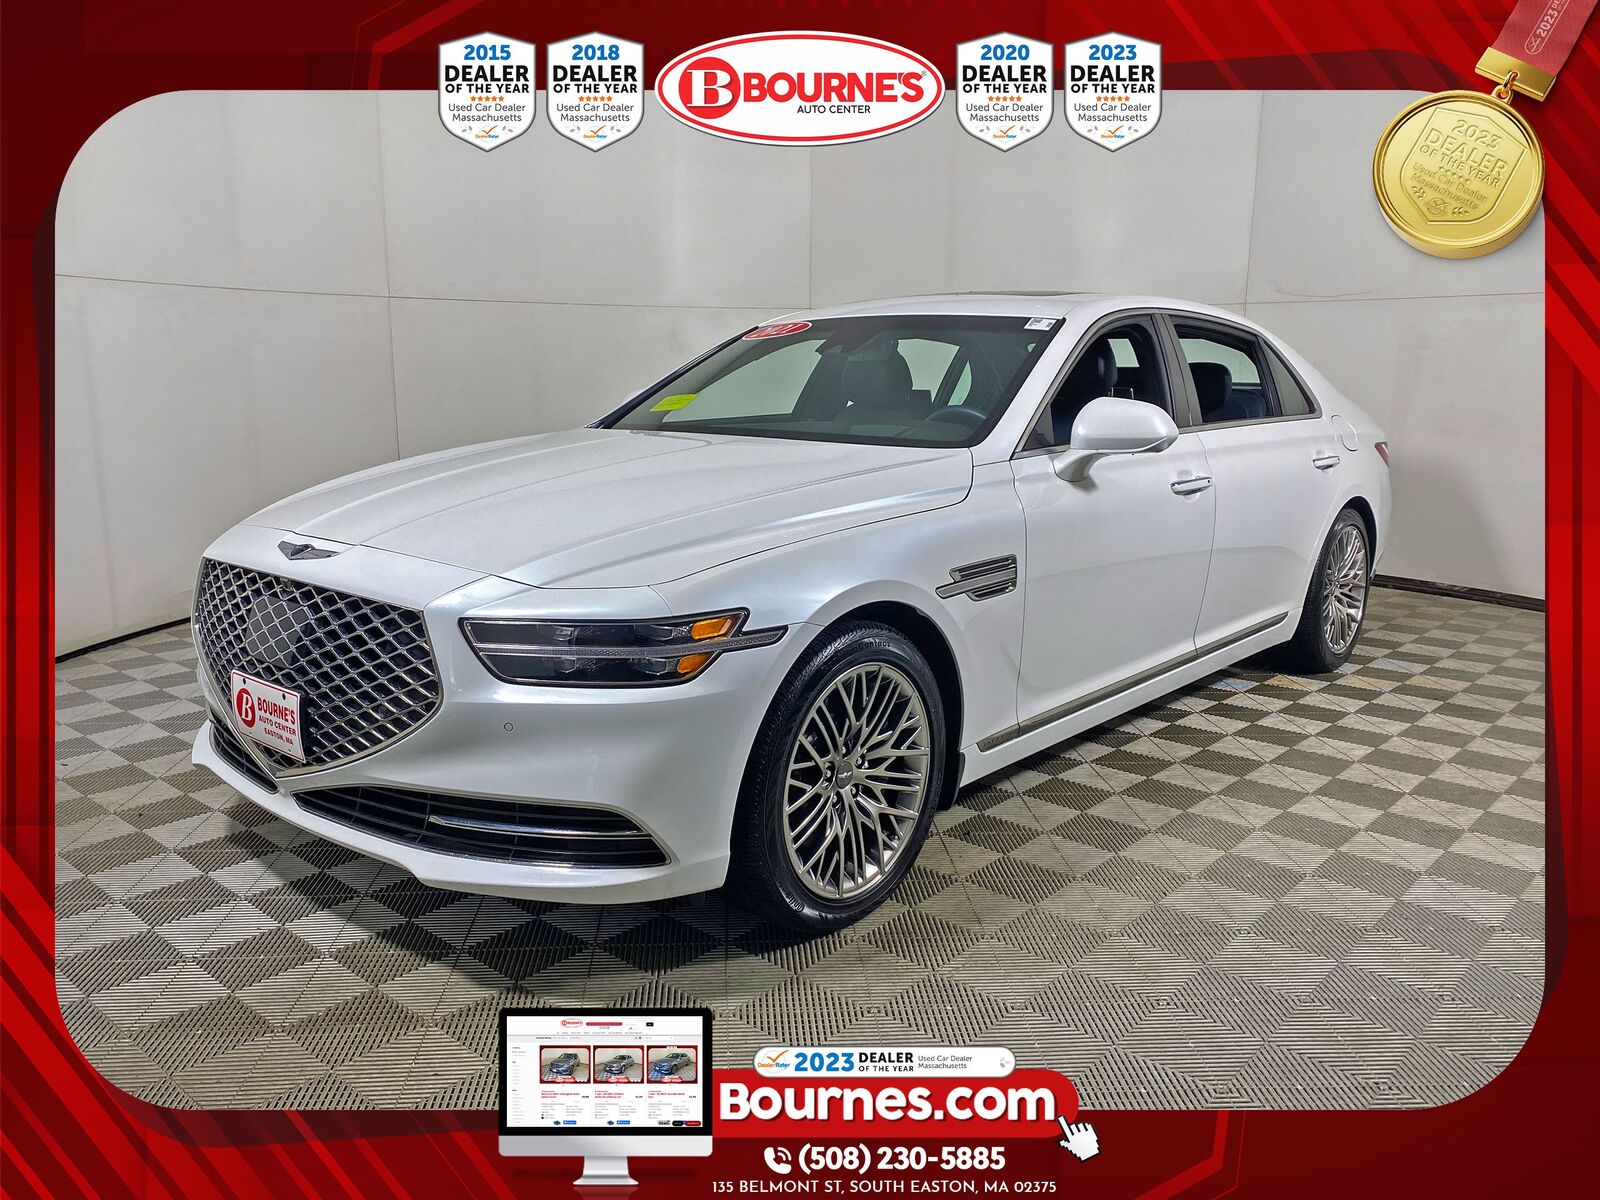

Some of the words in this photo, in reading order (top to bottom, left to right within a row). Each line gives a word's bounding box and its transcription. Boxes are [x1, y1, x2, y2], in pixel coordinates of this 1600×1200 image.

[257, 697, 296, 725] BOURNE'S
[259, 715, 274, 727] AUTO
[274, 721, 297, 736] CENTER
